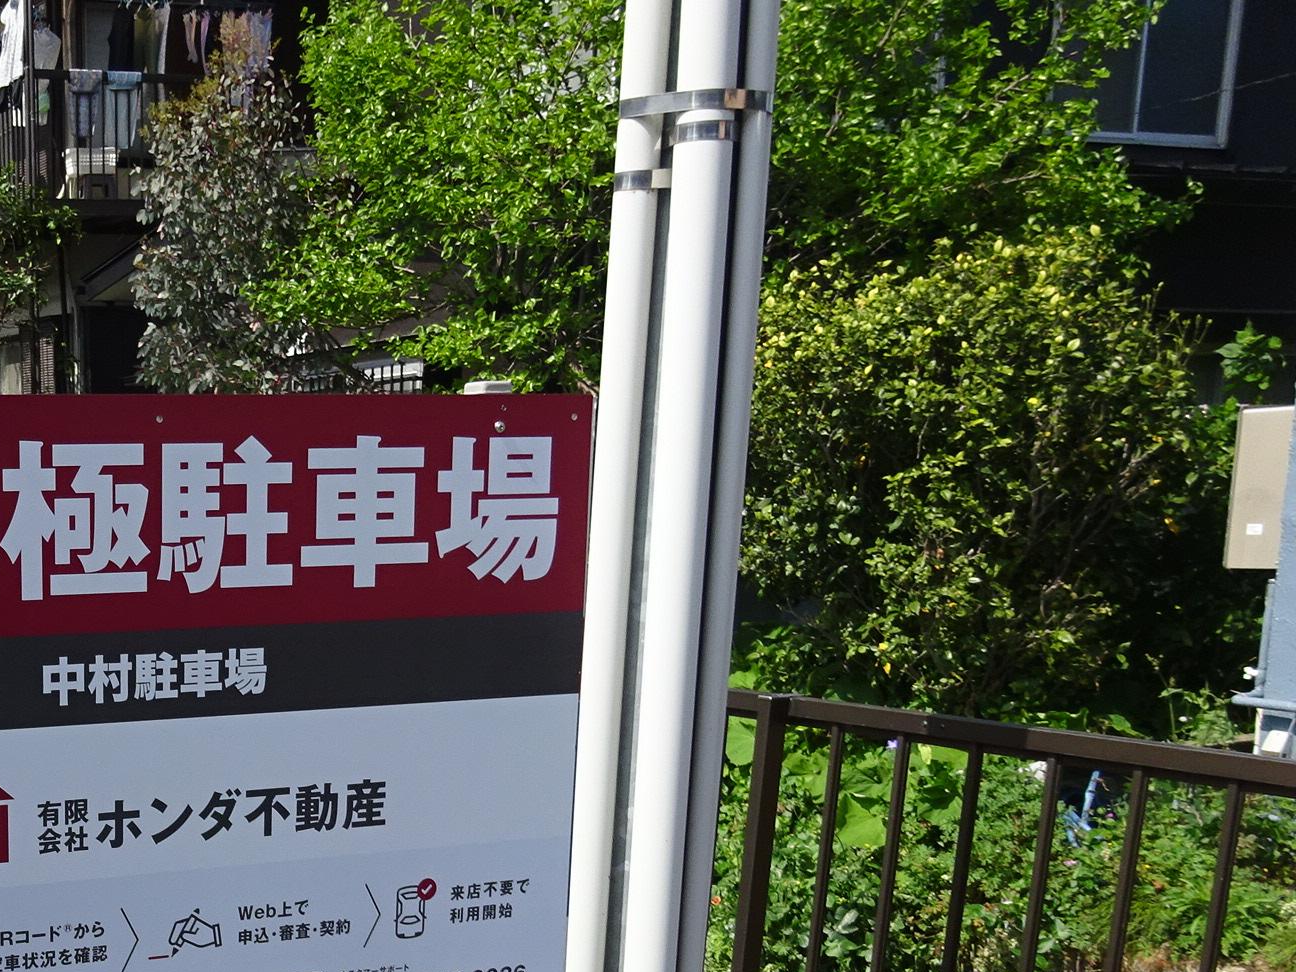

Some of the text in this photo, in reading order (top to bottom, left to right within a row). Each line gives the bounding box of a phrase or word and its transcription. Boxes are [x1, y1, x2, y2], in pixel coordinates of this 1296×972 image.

[42, 648, 267, 707] 中村駐車場
[37, 799, 89, 826] 有限
[96, 779, 387, 849] ホンダ不動産
[37, 827, 89, 855] 会社
[450, 878, 530, 901] 来店不要で
[238, 899, 309, 921] Web上で
[449, 903, 513, 924] 利用開始
